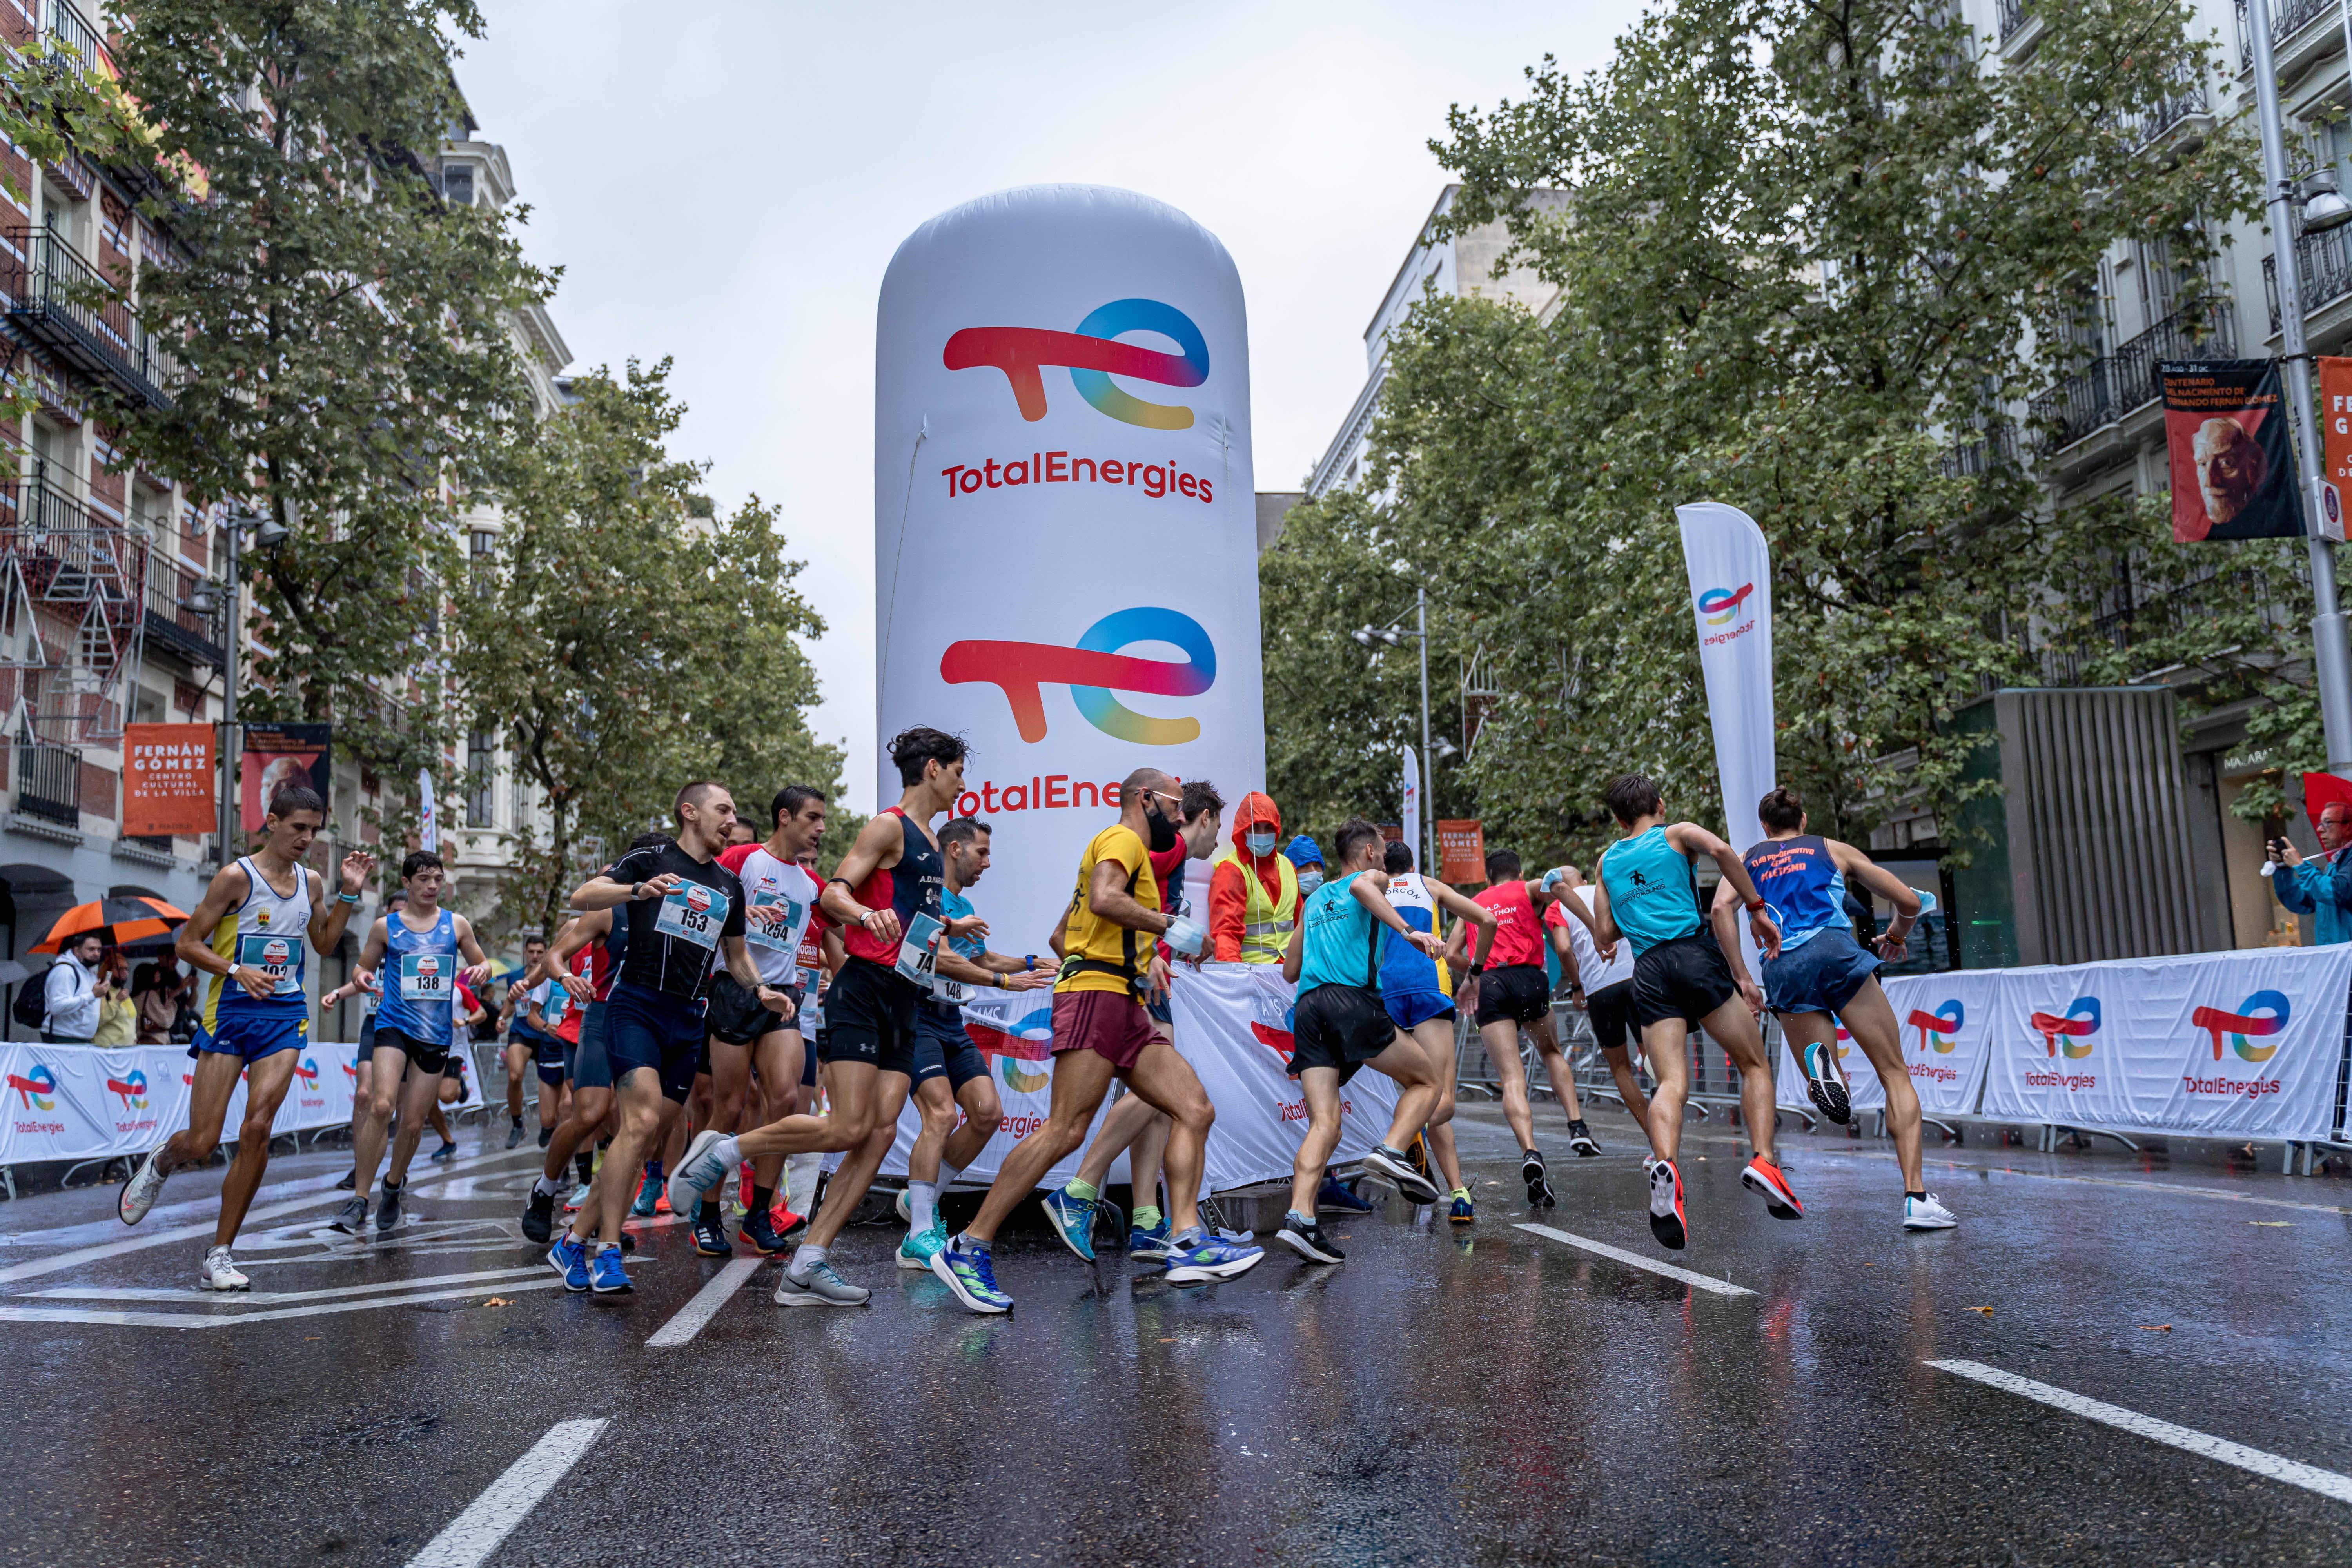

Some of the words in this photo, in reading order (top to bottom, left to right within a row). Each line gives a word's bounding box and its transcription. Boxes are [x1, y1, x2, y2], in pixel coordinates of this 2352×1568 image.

[2189, 364, 2197, 372] 31
[2178, 387, 2233, 396] NACIMIENTO
[2236, 387, 2245, 395] DE
[2210, 396, 2243, 405] FERNÁN
[941, 451, 1213, 504] TotalEnergies
[134, 742, 205, 757] FERNÁN
[134, 756, 205, 771] GÓMEZ
[142, 780, 198, 789] CULTURAL
[173, 789, 205, 797] VILLA
[1490, 906, 1516, 916] THON
[681, 908, 709, 933] 153
[416, 976, 439, 990] 138
[945, 981, 962, 1000] 148
